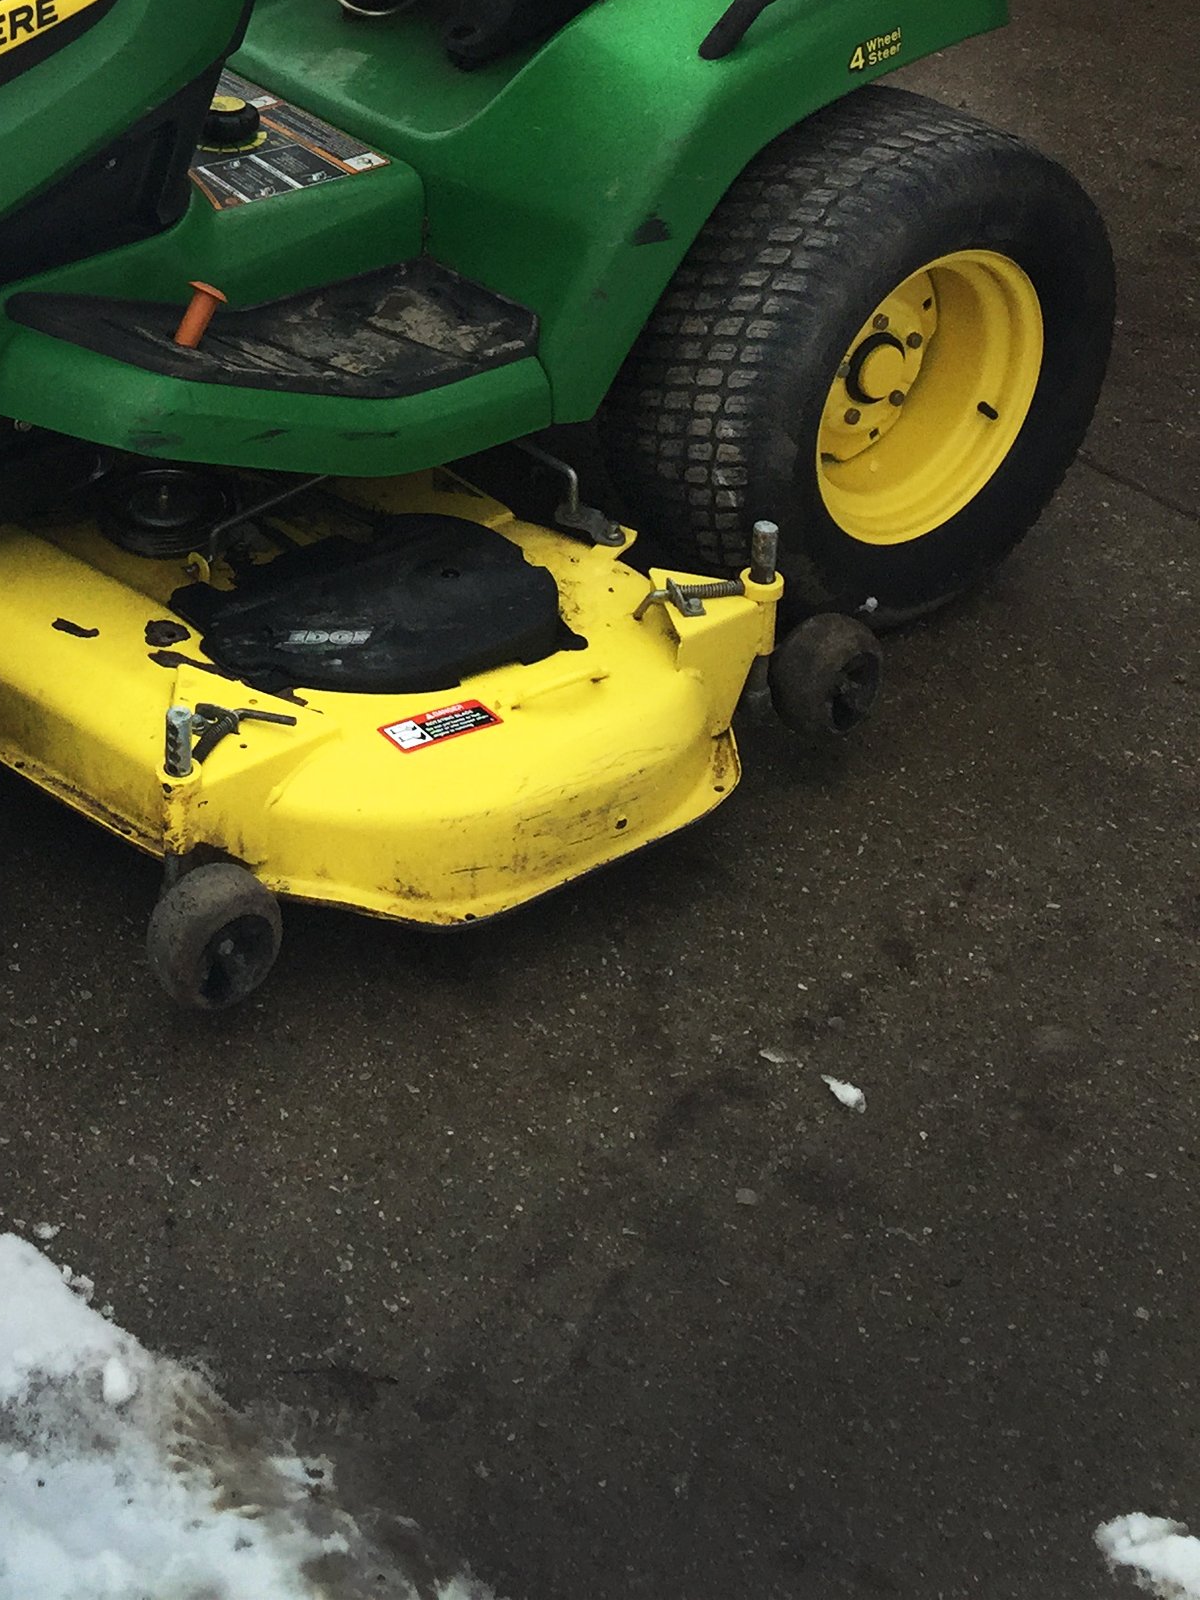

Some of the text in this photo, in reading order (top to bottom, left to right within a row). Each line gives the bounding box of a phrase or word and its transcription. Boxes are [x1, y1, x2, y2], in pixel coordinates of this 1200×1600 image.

[866, 26, 901, 52] Wheel
[849, 46, 865, 70] 4
[868, 42, 902, 66] Steer
